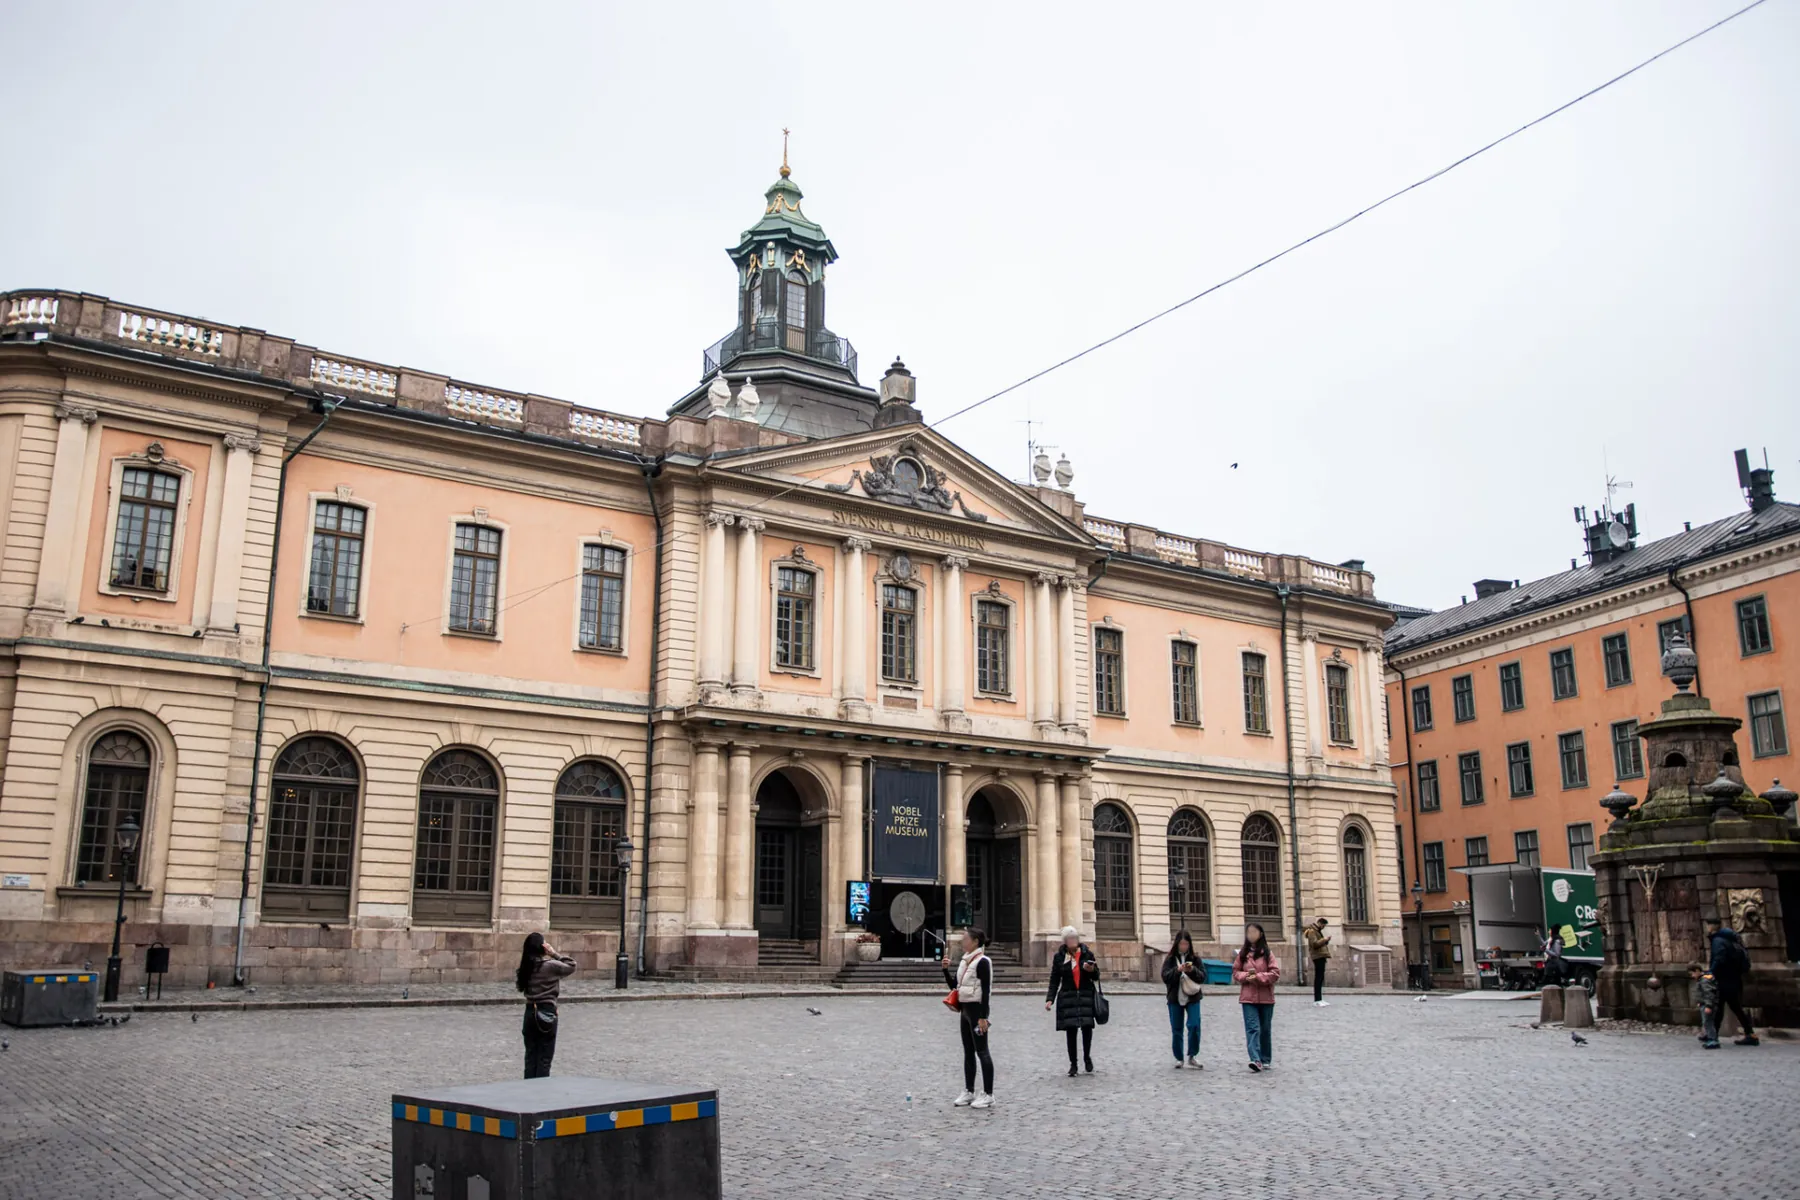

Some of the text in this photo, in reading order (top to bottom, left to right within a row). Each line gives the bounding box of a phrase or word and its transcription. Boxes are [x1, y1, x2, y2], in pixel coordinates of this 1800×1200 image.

[833, 511, 985, 549] SVENSKA AKADEMIEN
[892, 805, 922, 816] NOBEL
[894, 816, 919, 826] PRIZE
[886, 826, 928, 837] MUSEUM
